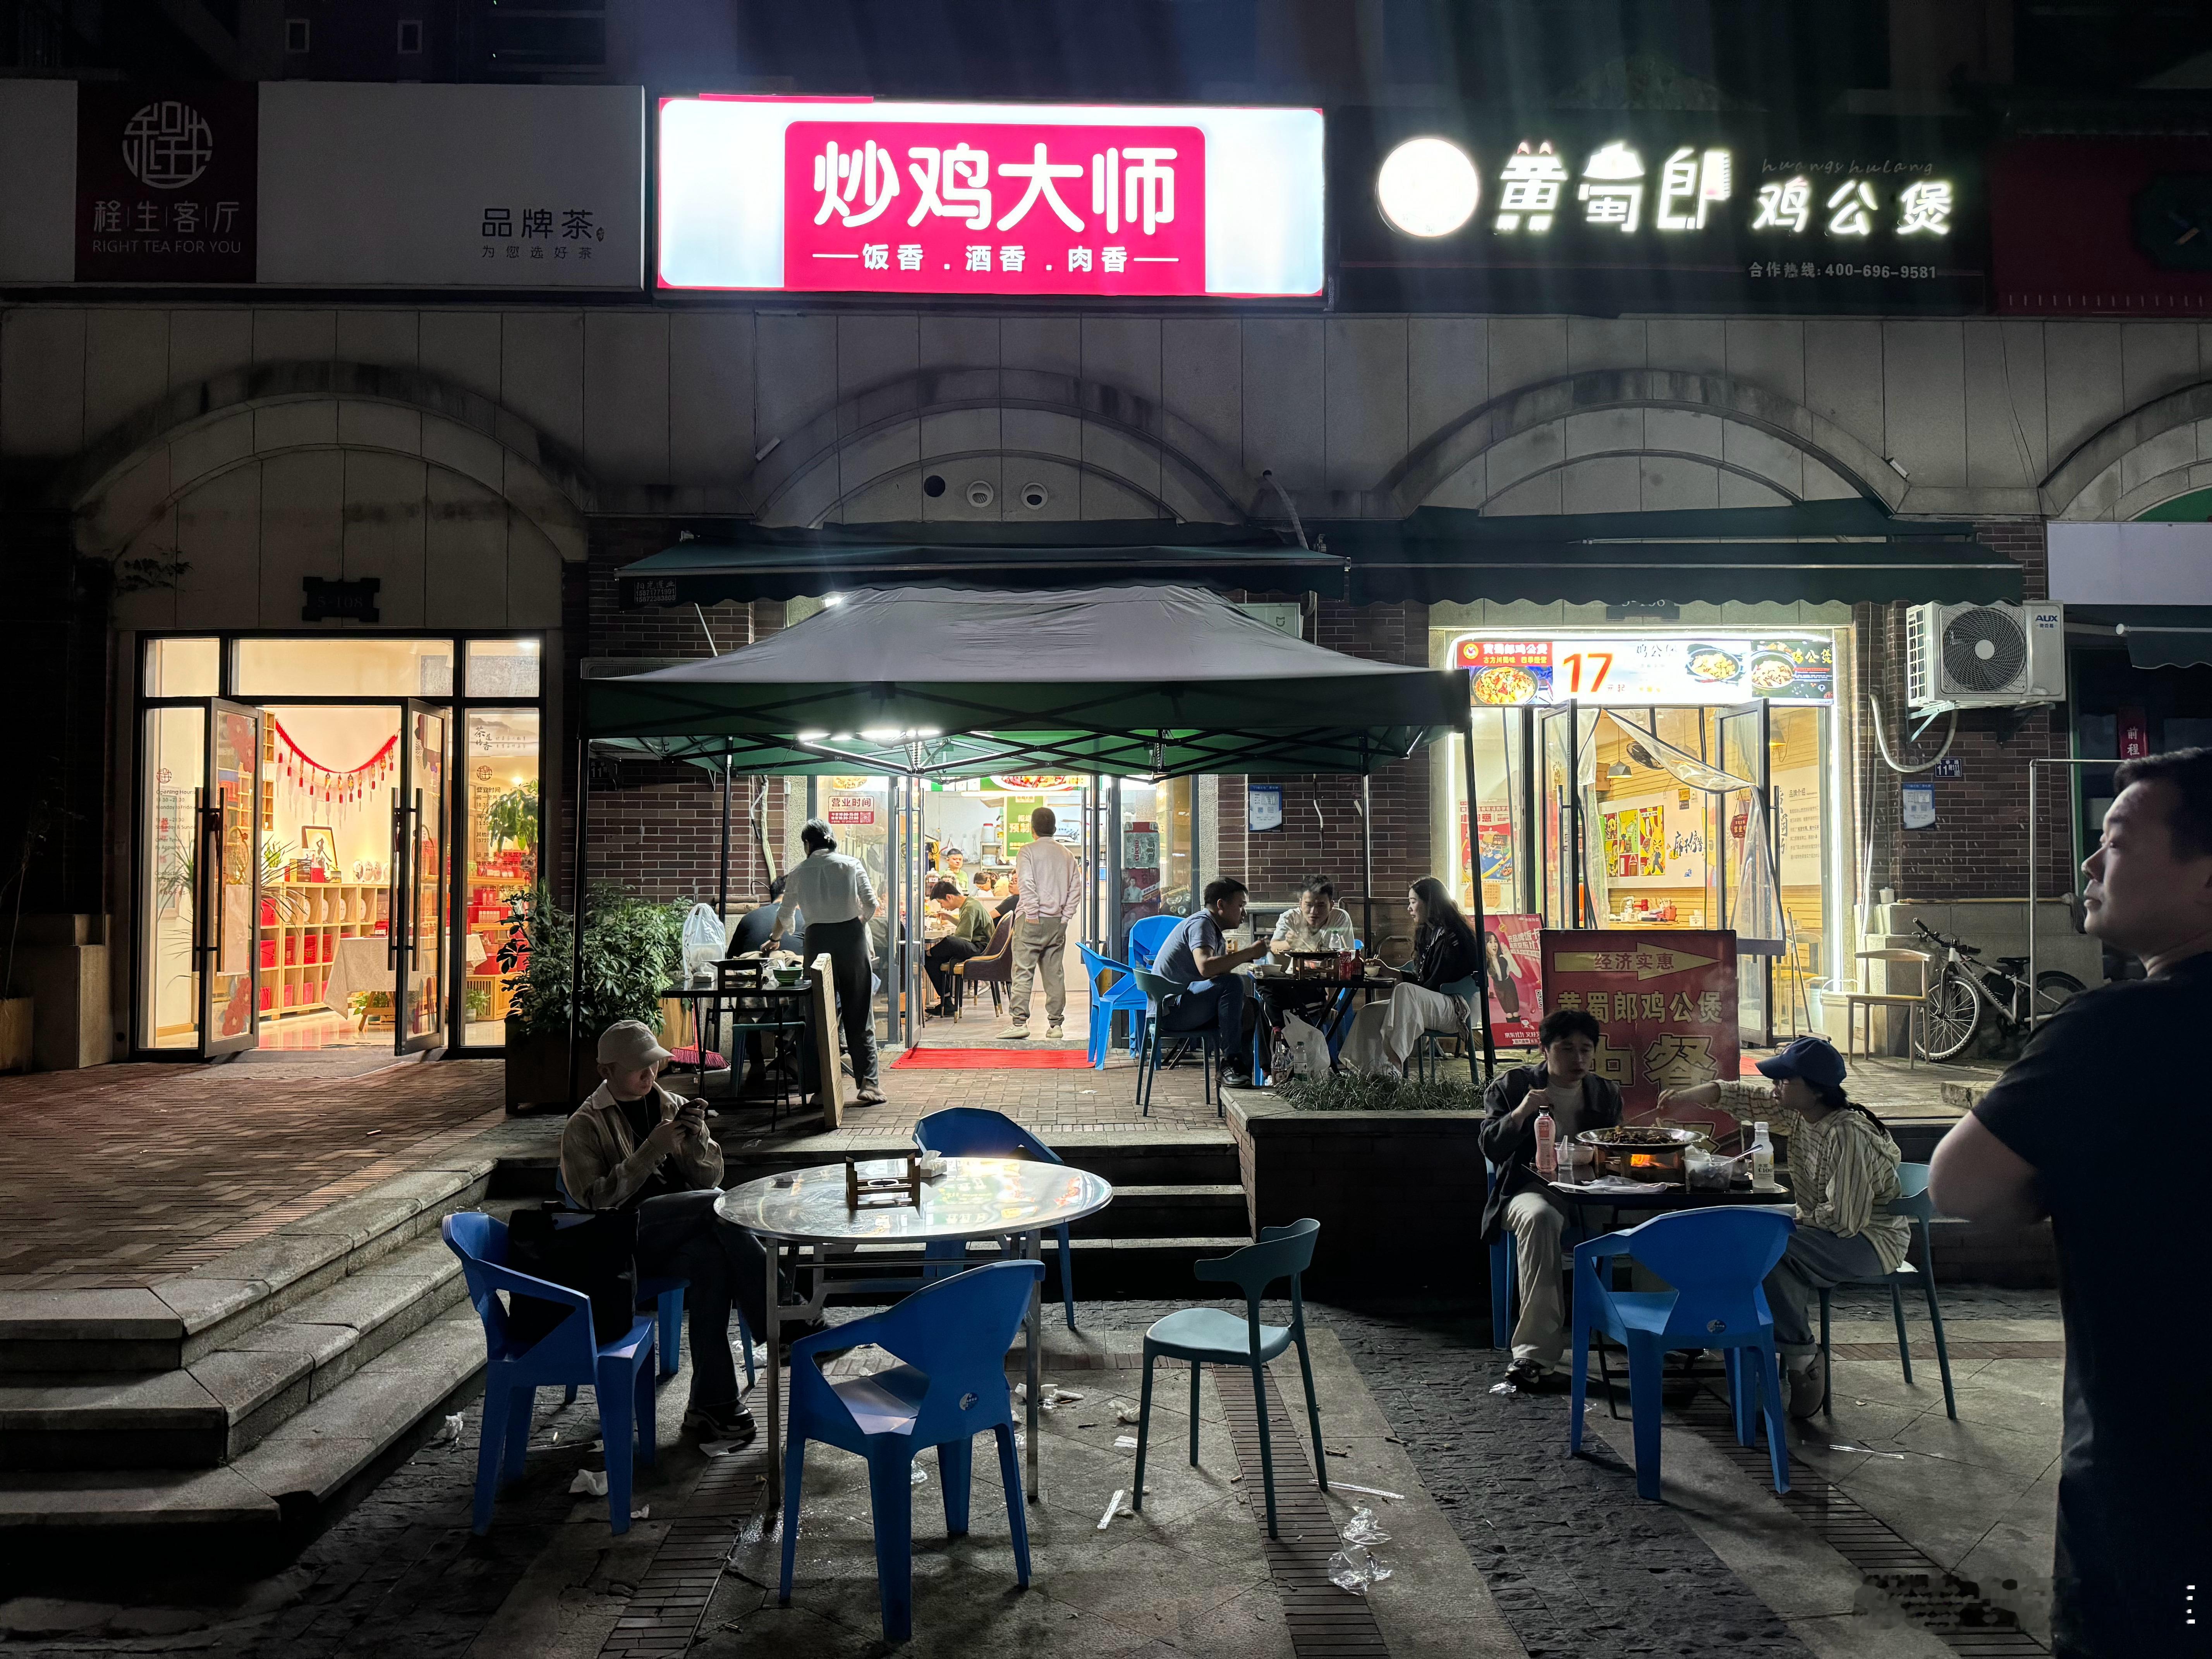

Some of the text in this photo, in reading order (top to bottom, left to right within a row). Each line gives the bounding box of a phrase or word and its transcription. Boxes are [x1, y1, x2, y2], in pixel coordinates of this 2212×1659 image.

[814, 139, 1178, 235] 炒鸡大师
[94, 200, 240, 233] 程生客厅
[1752, 175, 1953, 236] 鸡公煲
[482, 208, 593, 240] 品牌茶
[93, 240, 241, 253] RIGHT TEA FOR YOU
[482, 245, 592, 259] 为您选好茶
[1563, 653, 1613, 692] 17
[832, 798, 871, 807] 营业时间
[1594, 953, 1674, 970] 经济实惠
